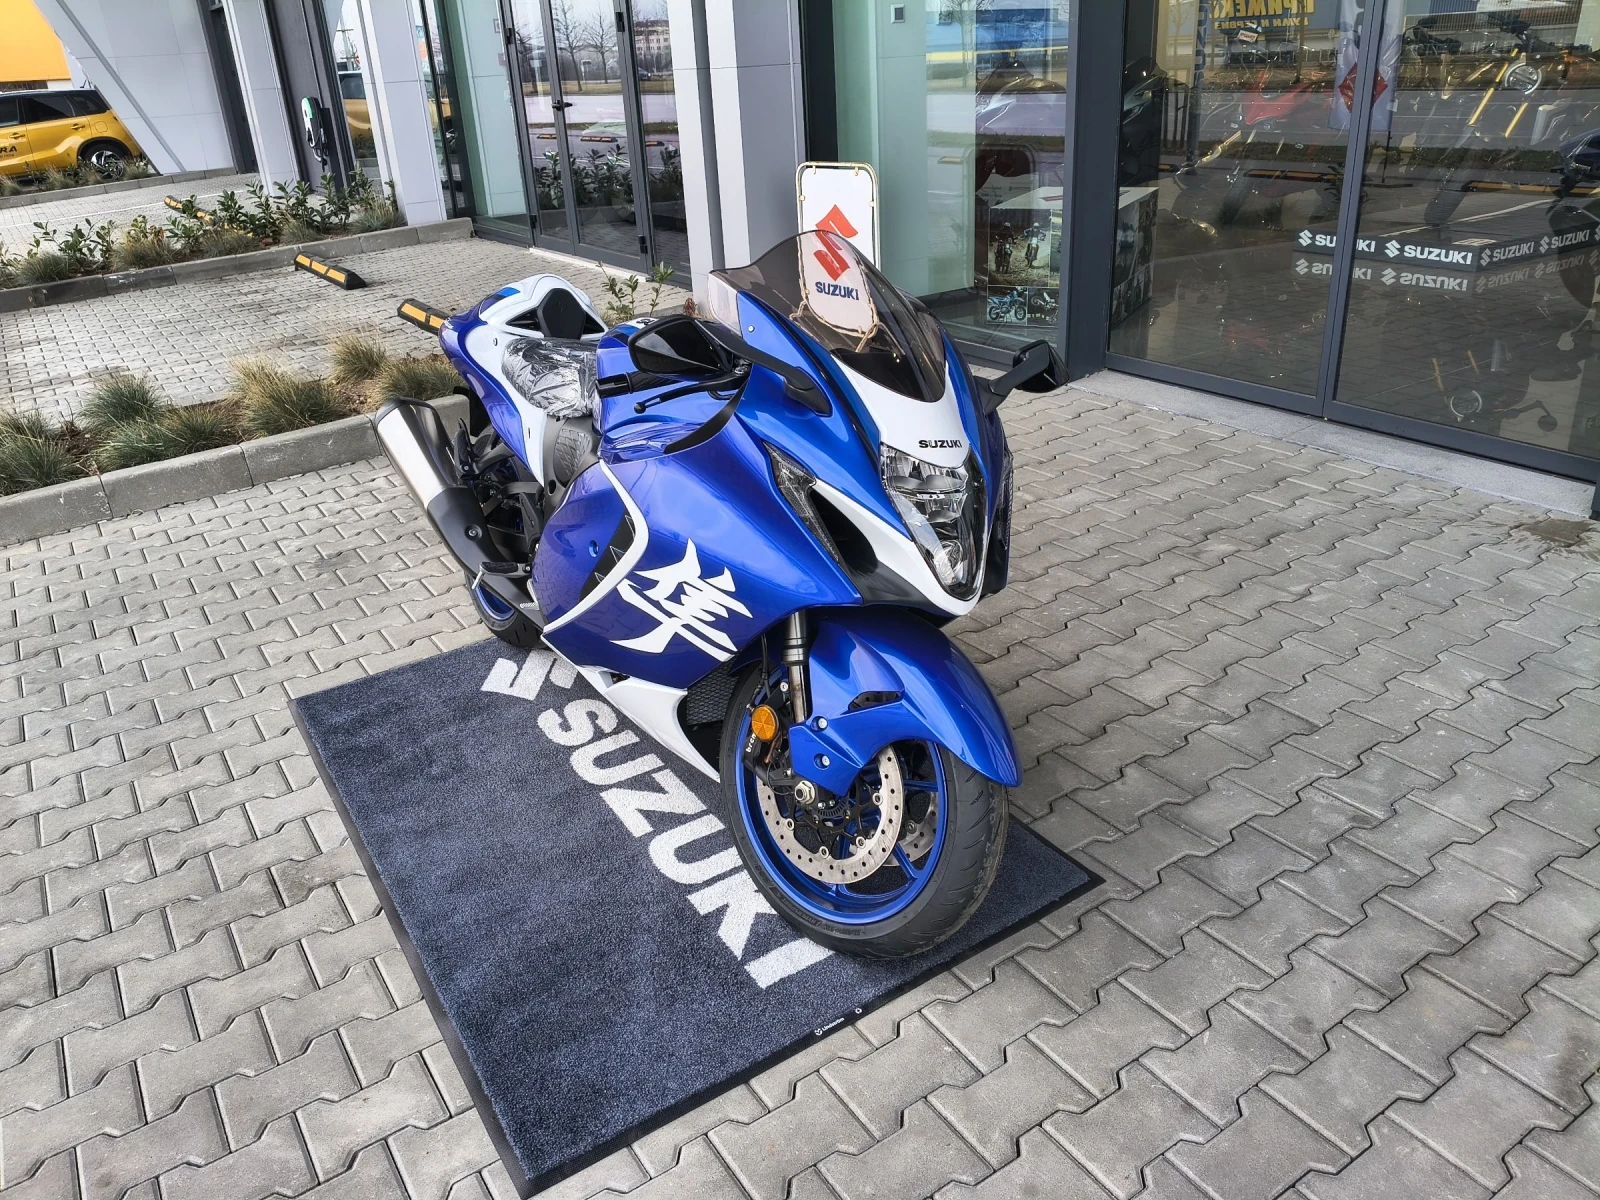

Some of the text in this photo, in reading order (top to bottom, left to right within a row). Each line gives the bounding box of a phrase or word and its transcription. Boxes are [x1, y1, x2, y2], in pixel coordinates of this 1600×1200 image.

[1403, 245, 1473, 265] SUZUKI
[1492, 230, 1590, 262] SUZUKI SUZUKI
[815, 281, 859, 301] SUZUKI
[918, 439, 963, 449] SUZUKI
[537, 698, 836, 990] SUZUKI
